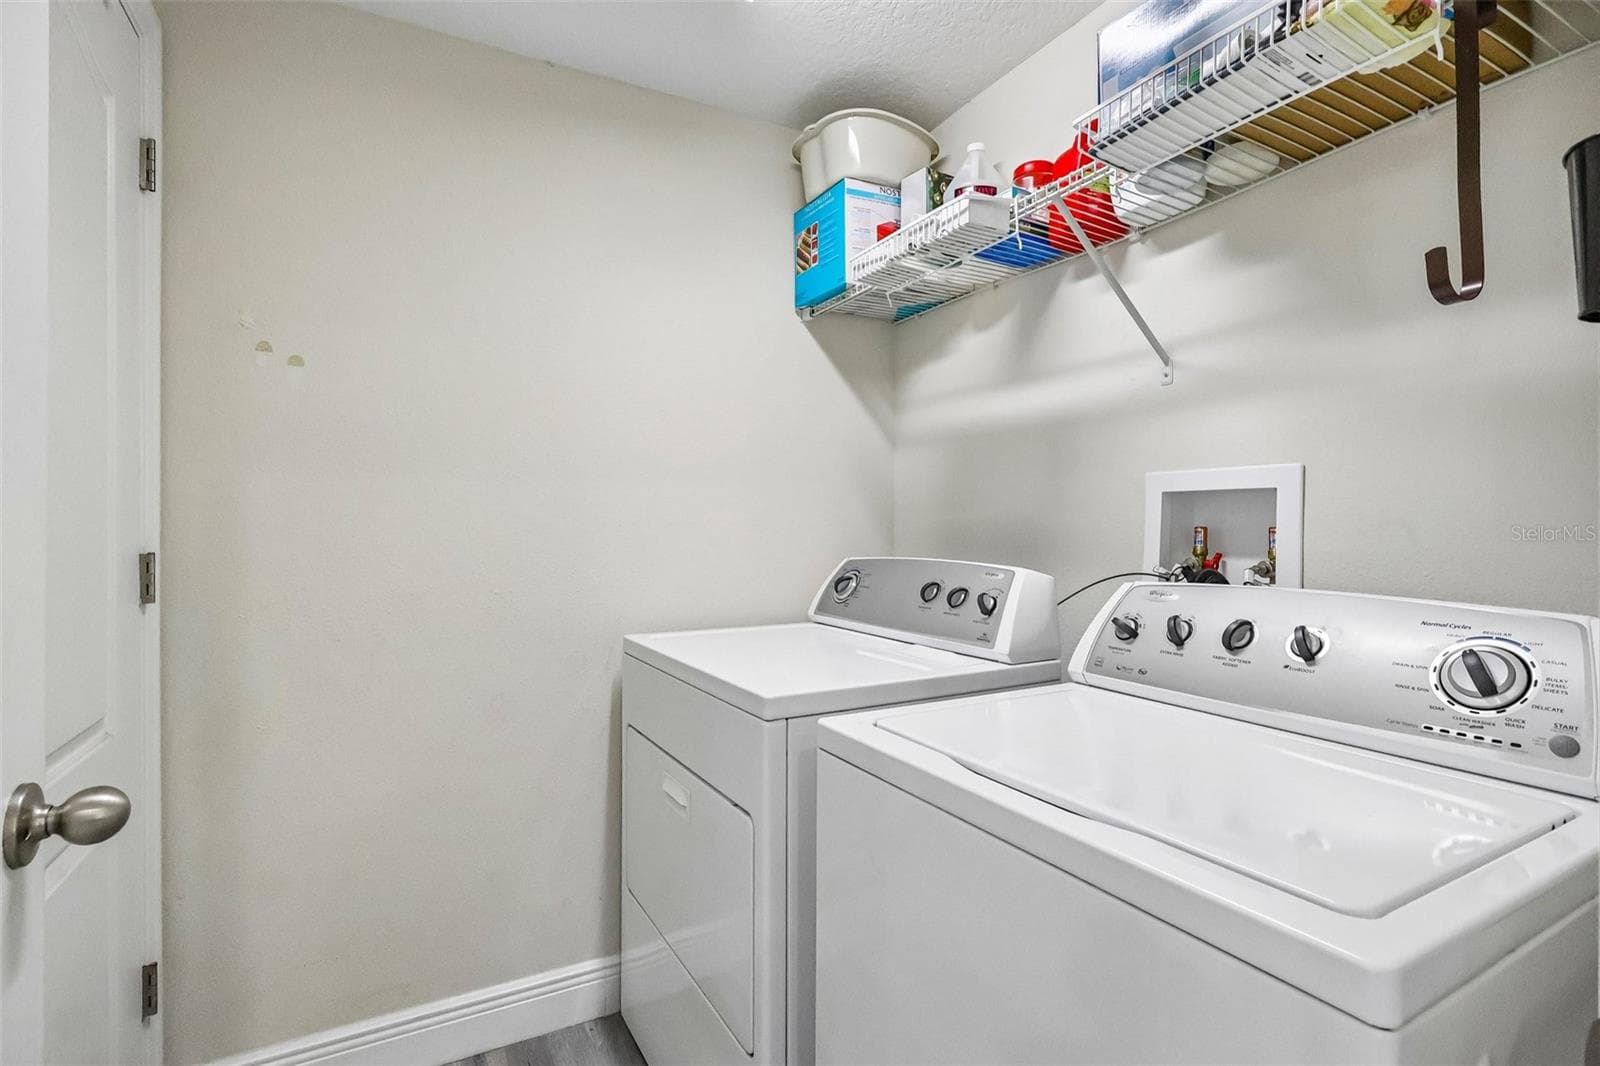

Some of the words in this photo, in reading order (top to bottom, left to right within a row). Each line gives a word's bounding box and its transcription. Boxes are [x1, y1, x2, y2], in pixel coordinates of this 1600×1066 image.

[1420, 620, 1448, 628] Normal
[1449, 623, 1472, 631] Cycles
[1531, 704, 1565, 714] DELICATE
[1452, 715, 1471, 723] CLEAN
[1553, 722, 1579, 732] START
